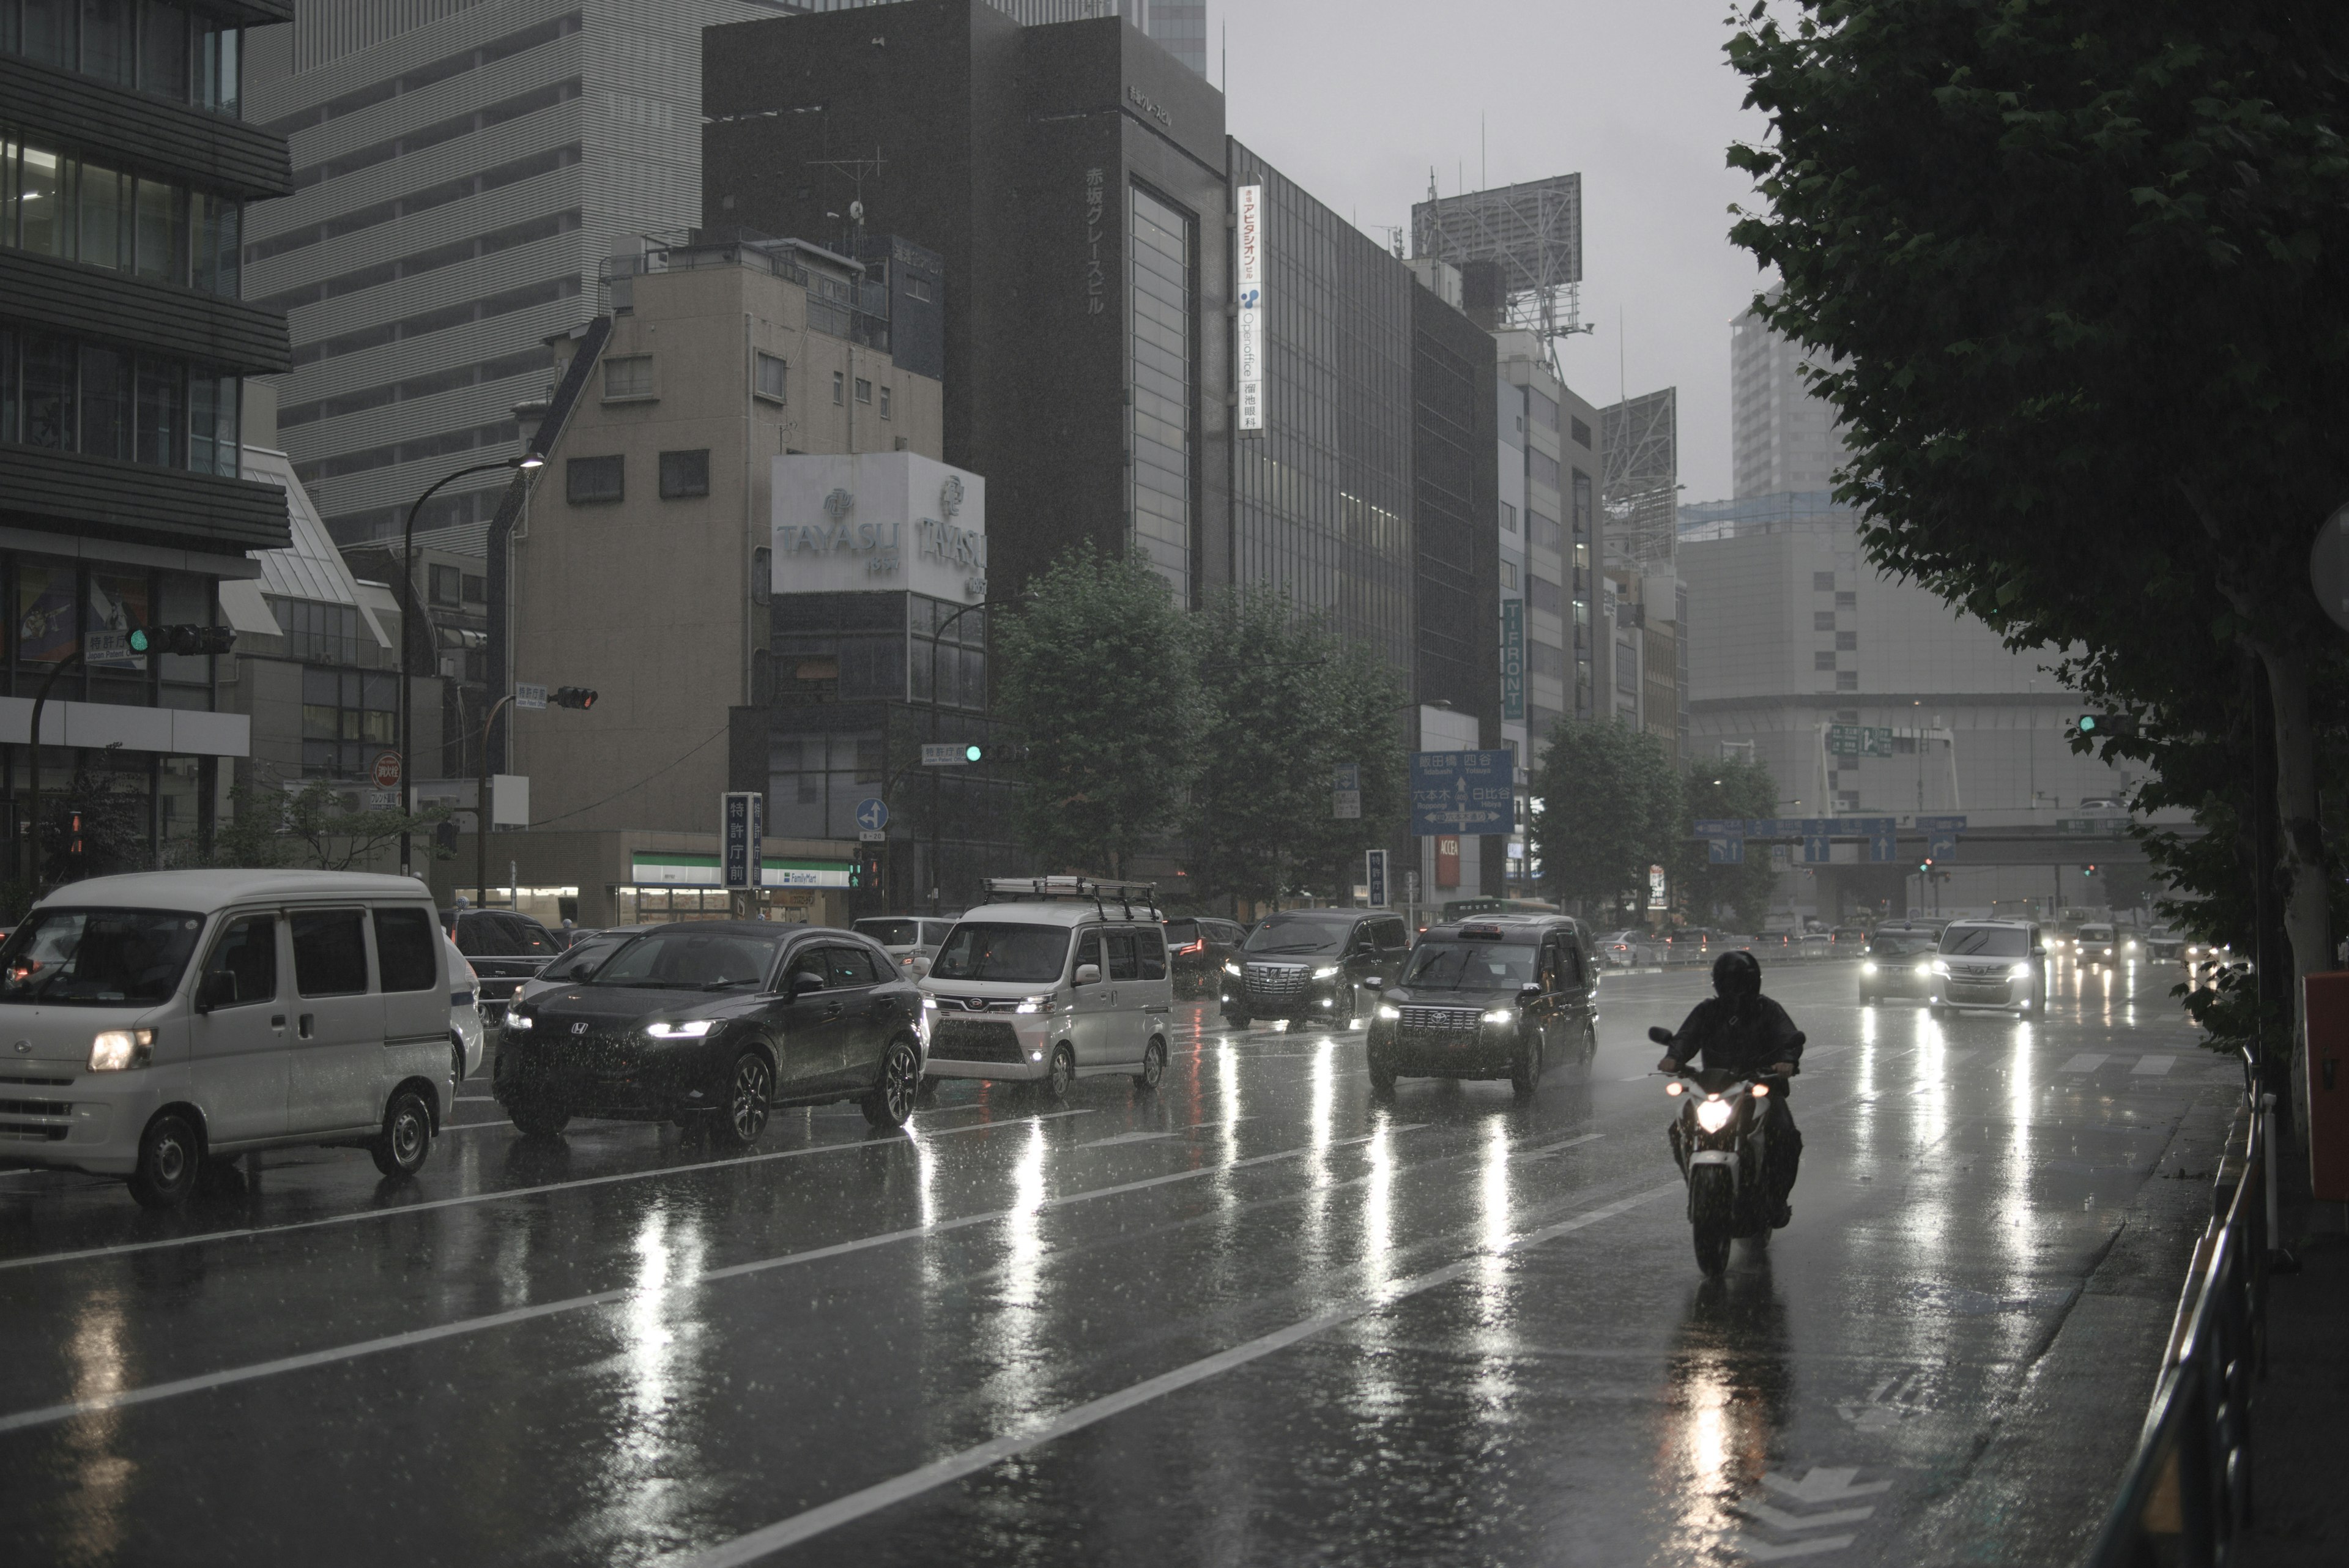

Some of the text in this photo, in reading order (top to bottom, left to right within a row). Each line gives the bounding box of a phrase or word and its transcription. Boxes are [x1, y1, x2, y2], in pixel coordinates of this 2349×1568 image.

[1086, 168, 1104, 314] 赤坂グレースビル
[1244, 190, 1255, 280] 赤坂アビタシオンビル
[1244, 313, 1255, 377] Openoffice
[1244, 384, 1256, 428] 溜池眼科
[777, 523, 900, 551] TAYASU
[919, 517, 987, 568] TAYASU
[865, 556, 900, 570] 1857
[90, 634, 126, 650] 特許庁
[1507, 604, 1520, 705] TIFRONT
[519, 687, 545, 700] 特許庁前
[926, 747, 965, 757] 特許庁前
[1419, 753, 1491, 768] 飯田橋 四谷
[378, 765, 399, 778] 消火栓
[1413, 789, 1451, 801] 六本木
[1473, 787, 1510, 800] 日比谷
[730, 802, 744, 880] 特許庁前
[1440, 840, 1458, 856] ACCEA
[791, 872, 817, 884] FamilyMart
[1371, 856, 1381, 902] 特許庁前
